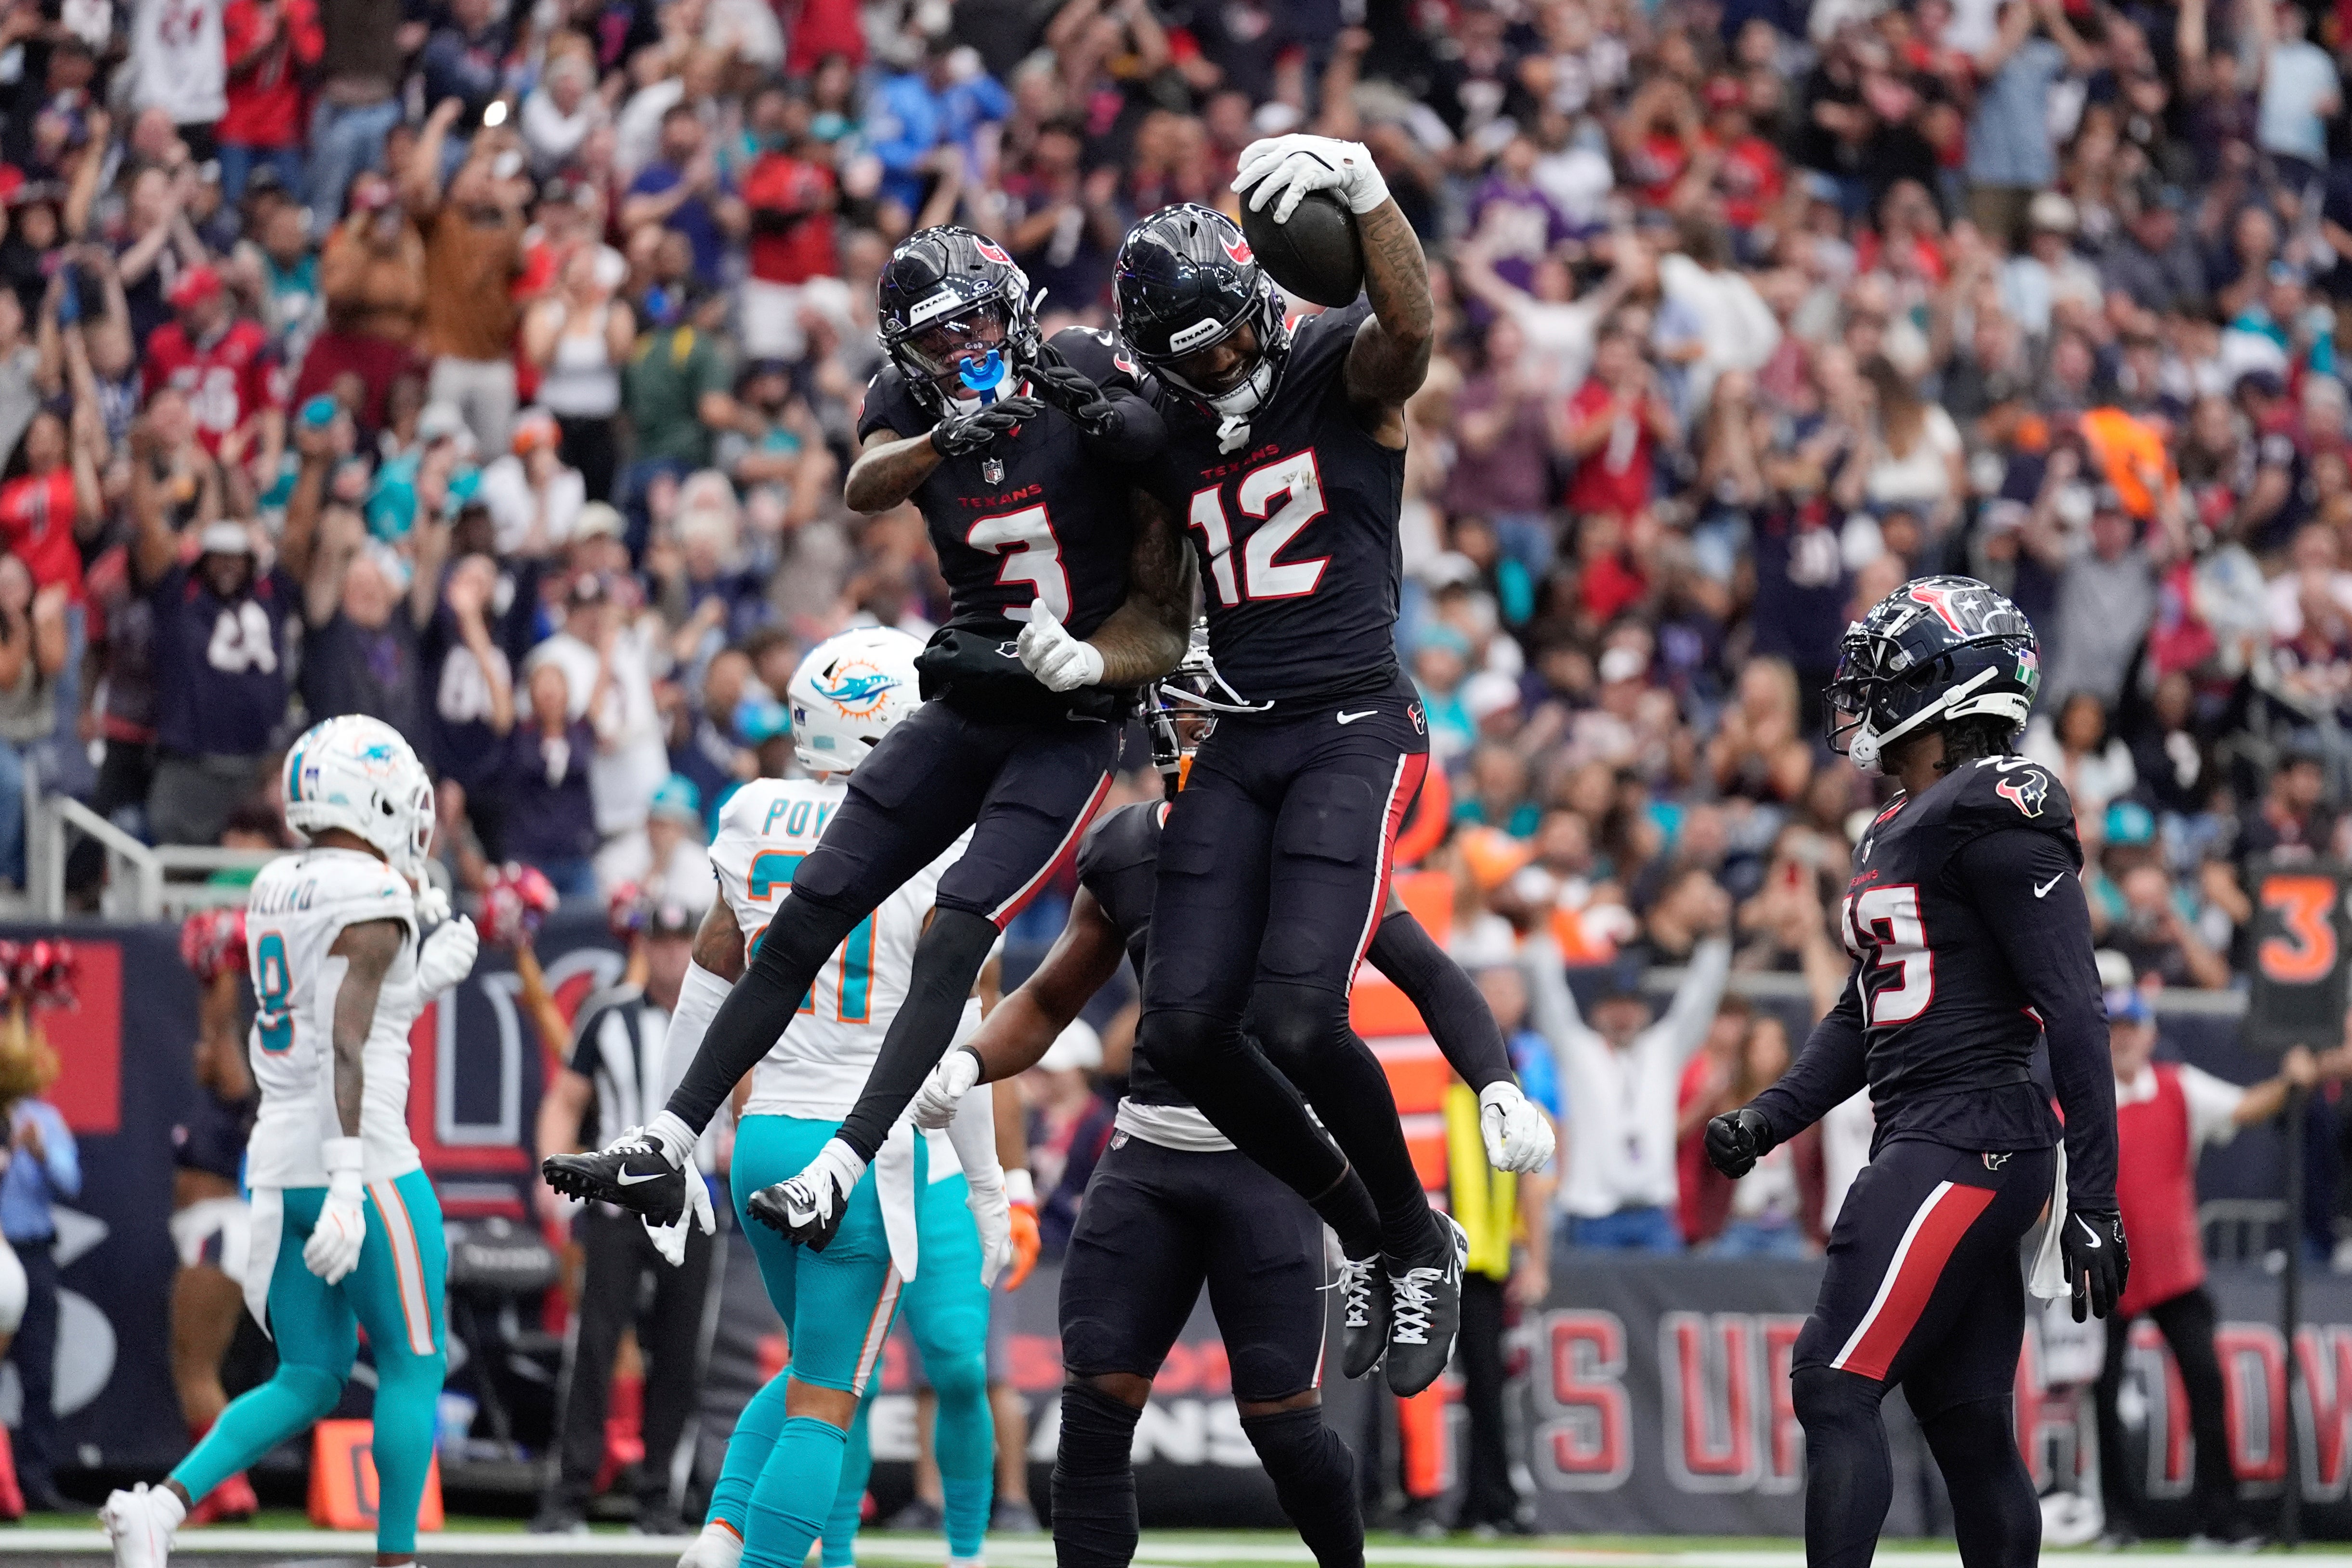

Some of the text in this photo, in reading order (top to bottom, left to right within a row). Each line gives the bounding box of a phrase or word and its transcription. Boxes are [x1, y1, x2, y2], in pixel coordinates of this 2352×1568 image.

[913, 293, 952, 314] TEXANS
[1174, 324, 1214, 345] TEXANS
[986, 468, 1002, 480] NFL
[1200, 444, 1280, 480] TEXANS
[957, 483, 1043, 508] TEXANS
[1188, 446, 1333, 608] 12
[965, 501, 1073, 626] 3
[1850, 869, 1879, 888] EXANS
[2259, 874, 2338, 983] 3
